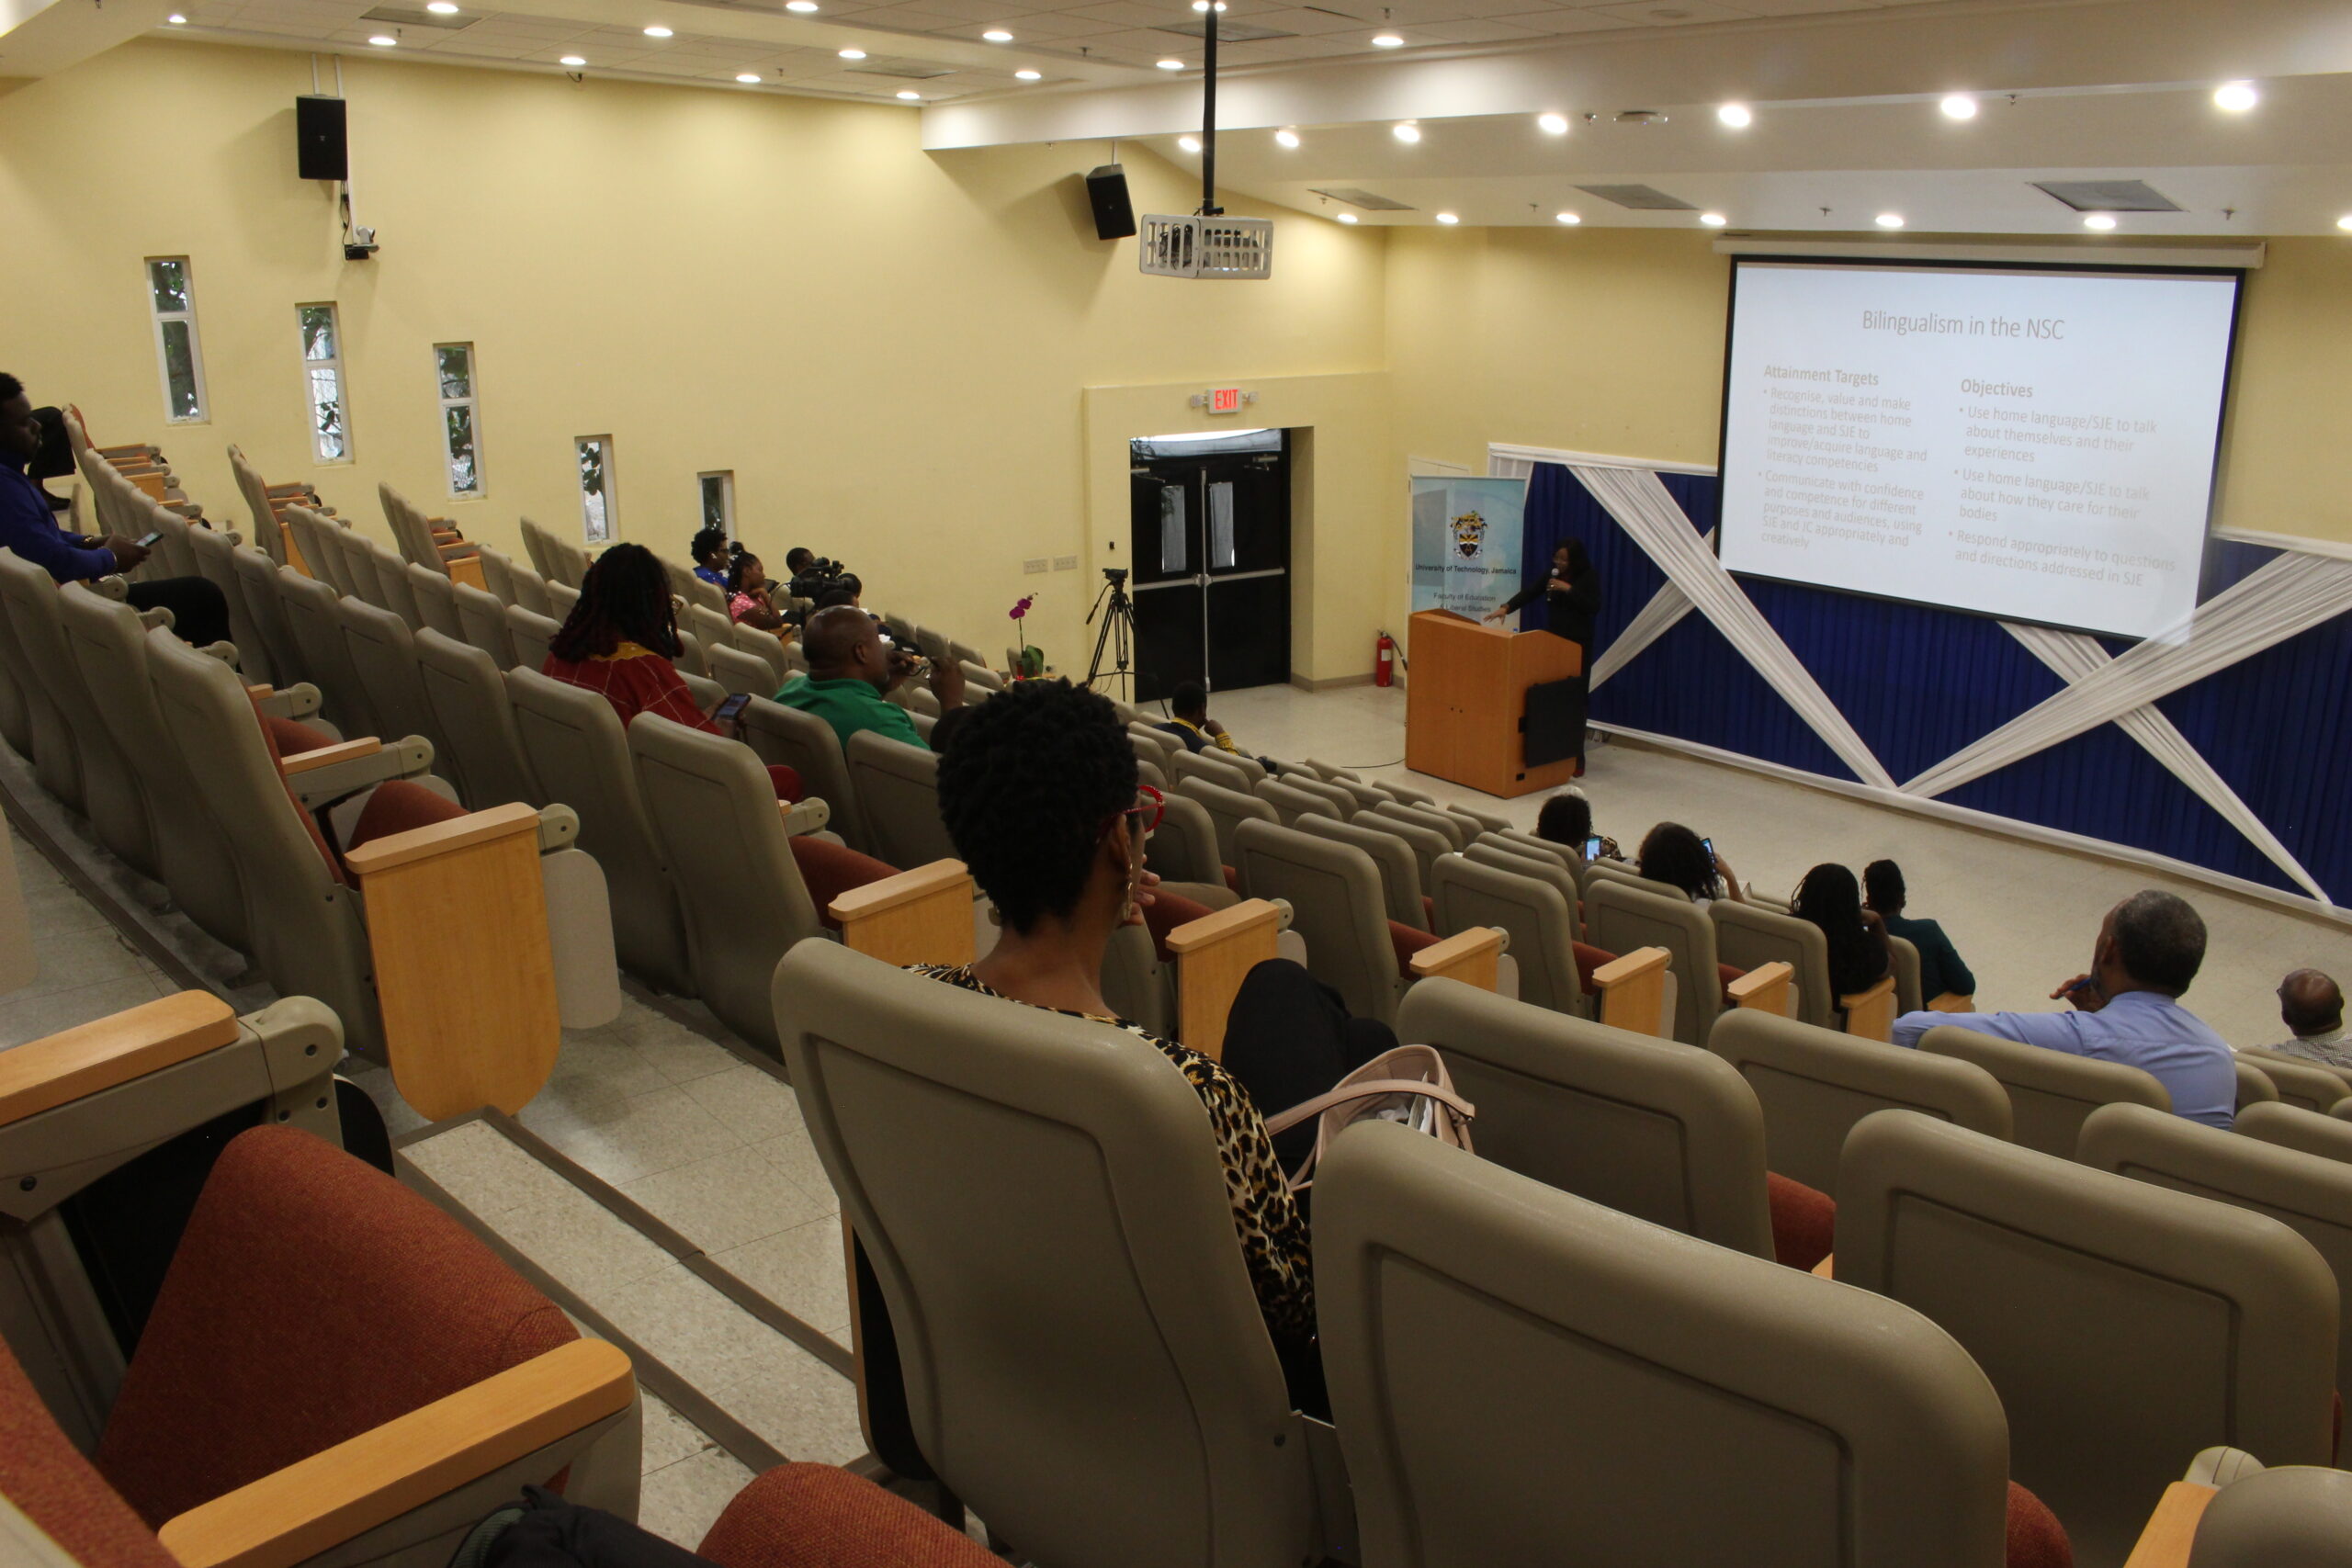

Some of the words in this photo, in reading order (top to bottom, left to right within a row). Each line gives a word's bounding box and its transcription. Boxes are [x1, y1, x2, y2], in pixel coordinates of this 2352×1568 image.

[1862, 310, 1963, 336] Bilingualism
[1968, 315, 1984, 335] in
[1990, 316, 2021, 338] the
[2027, 318, 2065, 340] NSC
[1764, 365, 1831, 382] Attainment
[1835, 369, 1879, 388] Targets
[1961, 378, 2033, 398] Objectives
[1215, 389, 1238, 410] EXIT
[1770, 387, 1825, 405] Recognise,
[1828, 392, 1855, 406] value
[1858, 395, 1878, 408] and
[1882, 397, 1911, 412] make
[1770, 403, 1827, 420] distinctions
[1830, 407, 1877, 424] between
[1880, 412, 1912, 427] home
[1968, 405, 1989, 420] Use
[1994, 407, 2028, 423] home
[2030, 411, 2113, 432] language/SJE
[2117, 419, 2130, 433] to
[2133, 419, 2158, 434] talk
[1769, 419, 1815, 435] language
[1816, 423, 1837, 436] and
[1838, 424, 1856, 438] SJE
[1859, 427, 1871, 440] to
[1965, 424, 2001, 440] about
[2004, 427, 2073, 447] themselves
[2075, 434, 2099, 449] and
[2103, 437, 2134, 453] their
[1766, 447, 1804, 467] literacy
[1805, 454, 1879, 473] competencies
[1768, 435, 1852, 455] improve/acquire
[1855, 442, 1904, 462] language
[1906, 447, 1928, 462] and
[1964, 444, 2035, 463] experiences
[1765, 469, 1836, 490] Communicate
[1838, 478, 1861, 492] with
[1864, 482, 1925, 501] confidence
[1962, 468, 1984, 483] Use
[1987, 469, 2022, 487] home
[2024, 474, 2106, 496] language/SJE
[2109, 484, 2122, 498] to
[2125, 486, 2150, 502] talk
[1764, 486, 1783, 499] and
[1786, 490, 1849, 507] competence
[1851, 496, 1867, 508] for
[1870, 498, 1917, 515] different
[1959, 504, 1998, 522] bodies
[1961, 487, 1995, 503] about
[1998, 490, 2023, 506] how
[2028, 493, 2054, 513] they
[2057, 500, 2084, 513] care
[2087, 500, 2105, 515] for
[2108, 503, 2140, 521] their
[1762, 514, 1778, 528] SJE
[1781, 518, 1799, 531] and
[1815, 524, 1886, 547] appropriately
[1888, 535, 1909, 547] and
[1763, 502, 1810, 518] purposes
[1812, 508, 1831, 521] and
[1834, 511, 1890, 530] audiences,
[1894, 520, 1923, 536] using
[1761, 532, 1810, 550] creatively
[1957, 529, 2007, 549] Respond
[2010, 537, 2091, 562] appropriately
[2095, 548, 2109, 562] to
[2111, 551, 2176, 572] questions
[1415, 564, 1444, 573] University
[1491, 567, 1517, 575] Jamaica
[1955, 548, 1977, 562] and
[1980, 550, 2038, 571] directions
[2041, 560, 2104, 581] addressed
[2108, 570, 2120, 583] in
[2123, 571, 2144, 587] SJE
